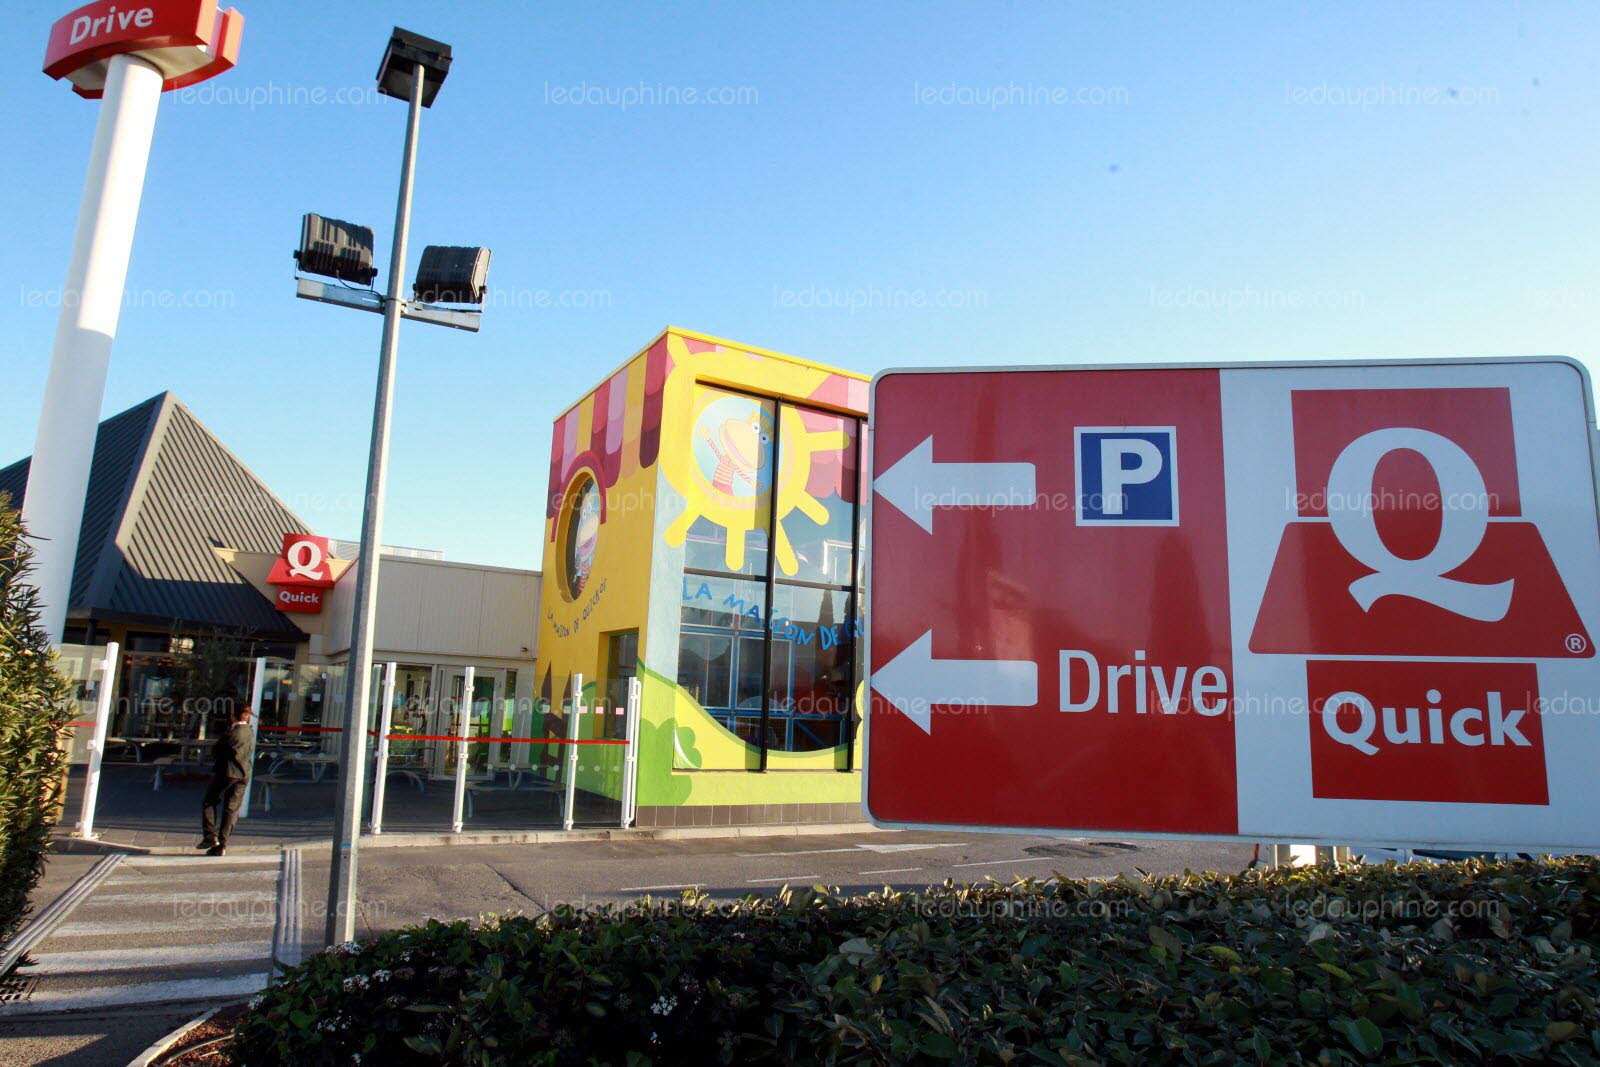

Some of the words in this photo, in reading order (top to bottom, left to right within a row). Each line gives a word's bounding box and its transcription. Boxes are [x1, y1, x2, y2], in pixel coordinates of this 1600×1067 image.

[70, 6, 153, 45] Drive
[1101, 439, 1162, 514] P
[1327, 427, 1514, 622] Q
[287, 540, 323, 580] Q
[279, 591, 319, 603] Quick
[682, 575, 712, 600] LA
[820, 625, 841, 650] DE
[1059, 649, 1228, 716] Drive
[1322, 688, 1533, 756] Quick
